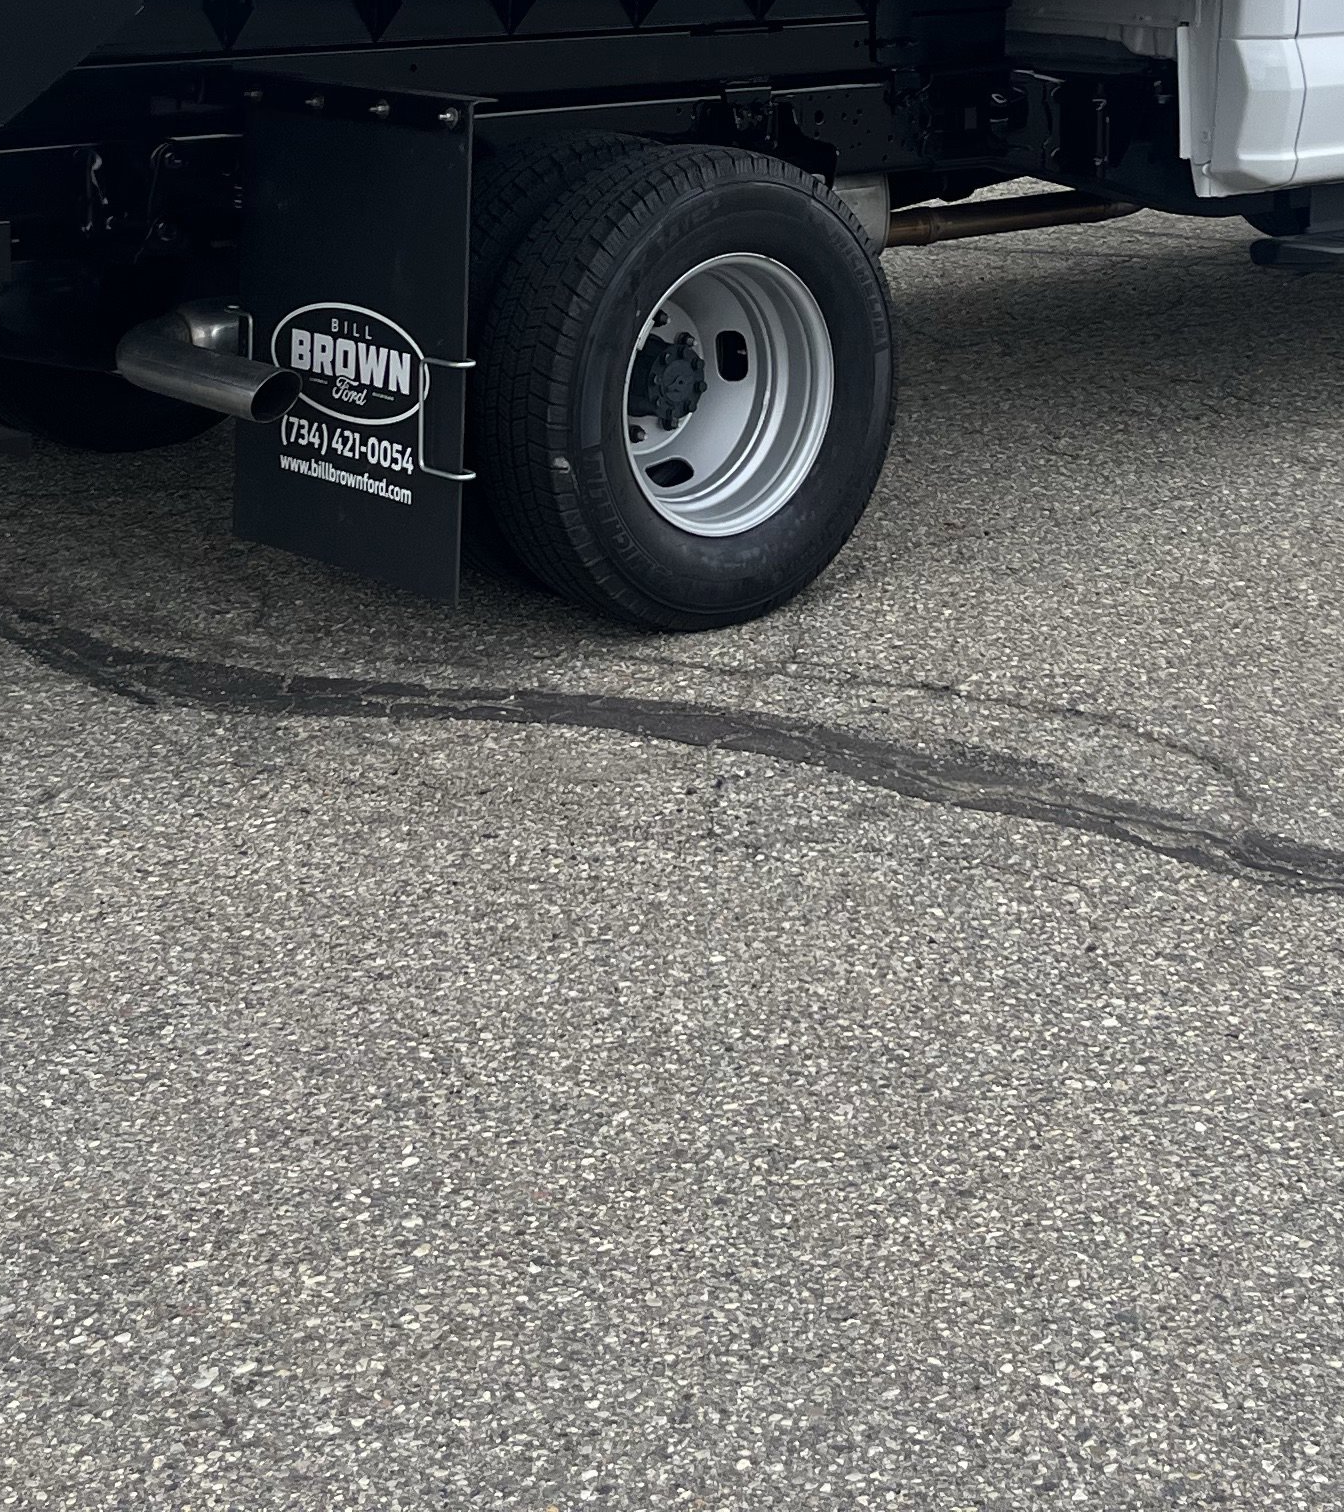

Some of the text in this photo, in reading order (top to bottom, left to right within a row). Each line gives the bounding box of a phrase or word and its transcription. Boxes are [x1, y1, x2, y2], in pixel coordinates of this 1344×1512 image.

[331, 318, 372, 340] BILL
[290, 328, 411, 396] BROWN
[332, 376, 367, 406] Ford
[281, 414, 415, 475] (734) 421-0054
[279, 453, 413, 505] www.billbrownford.com
